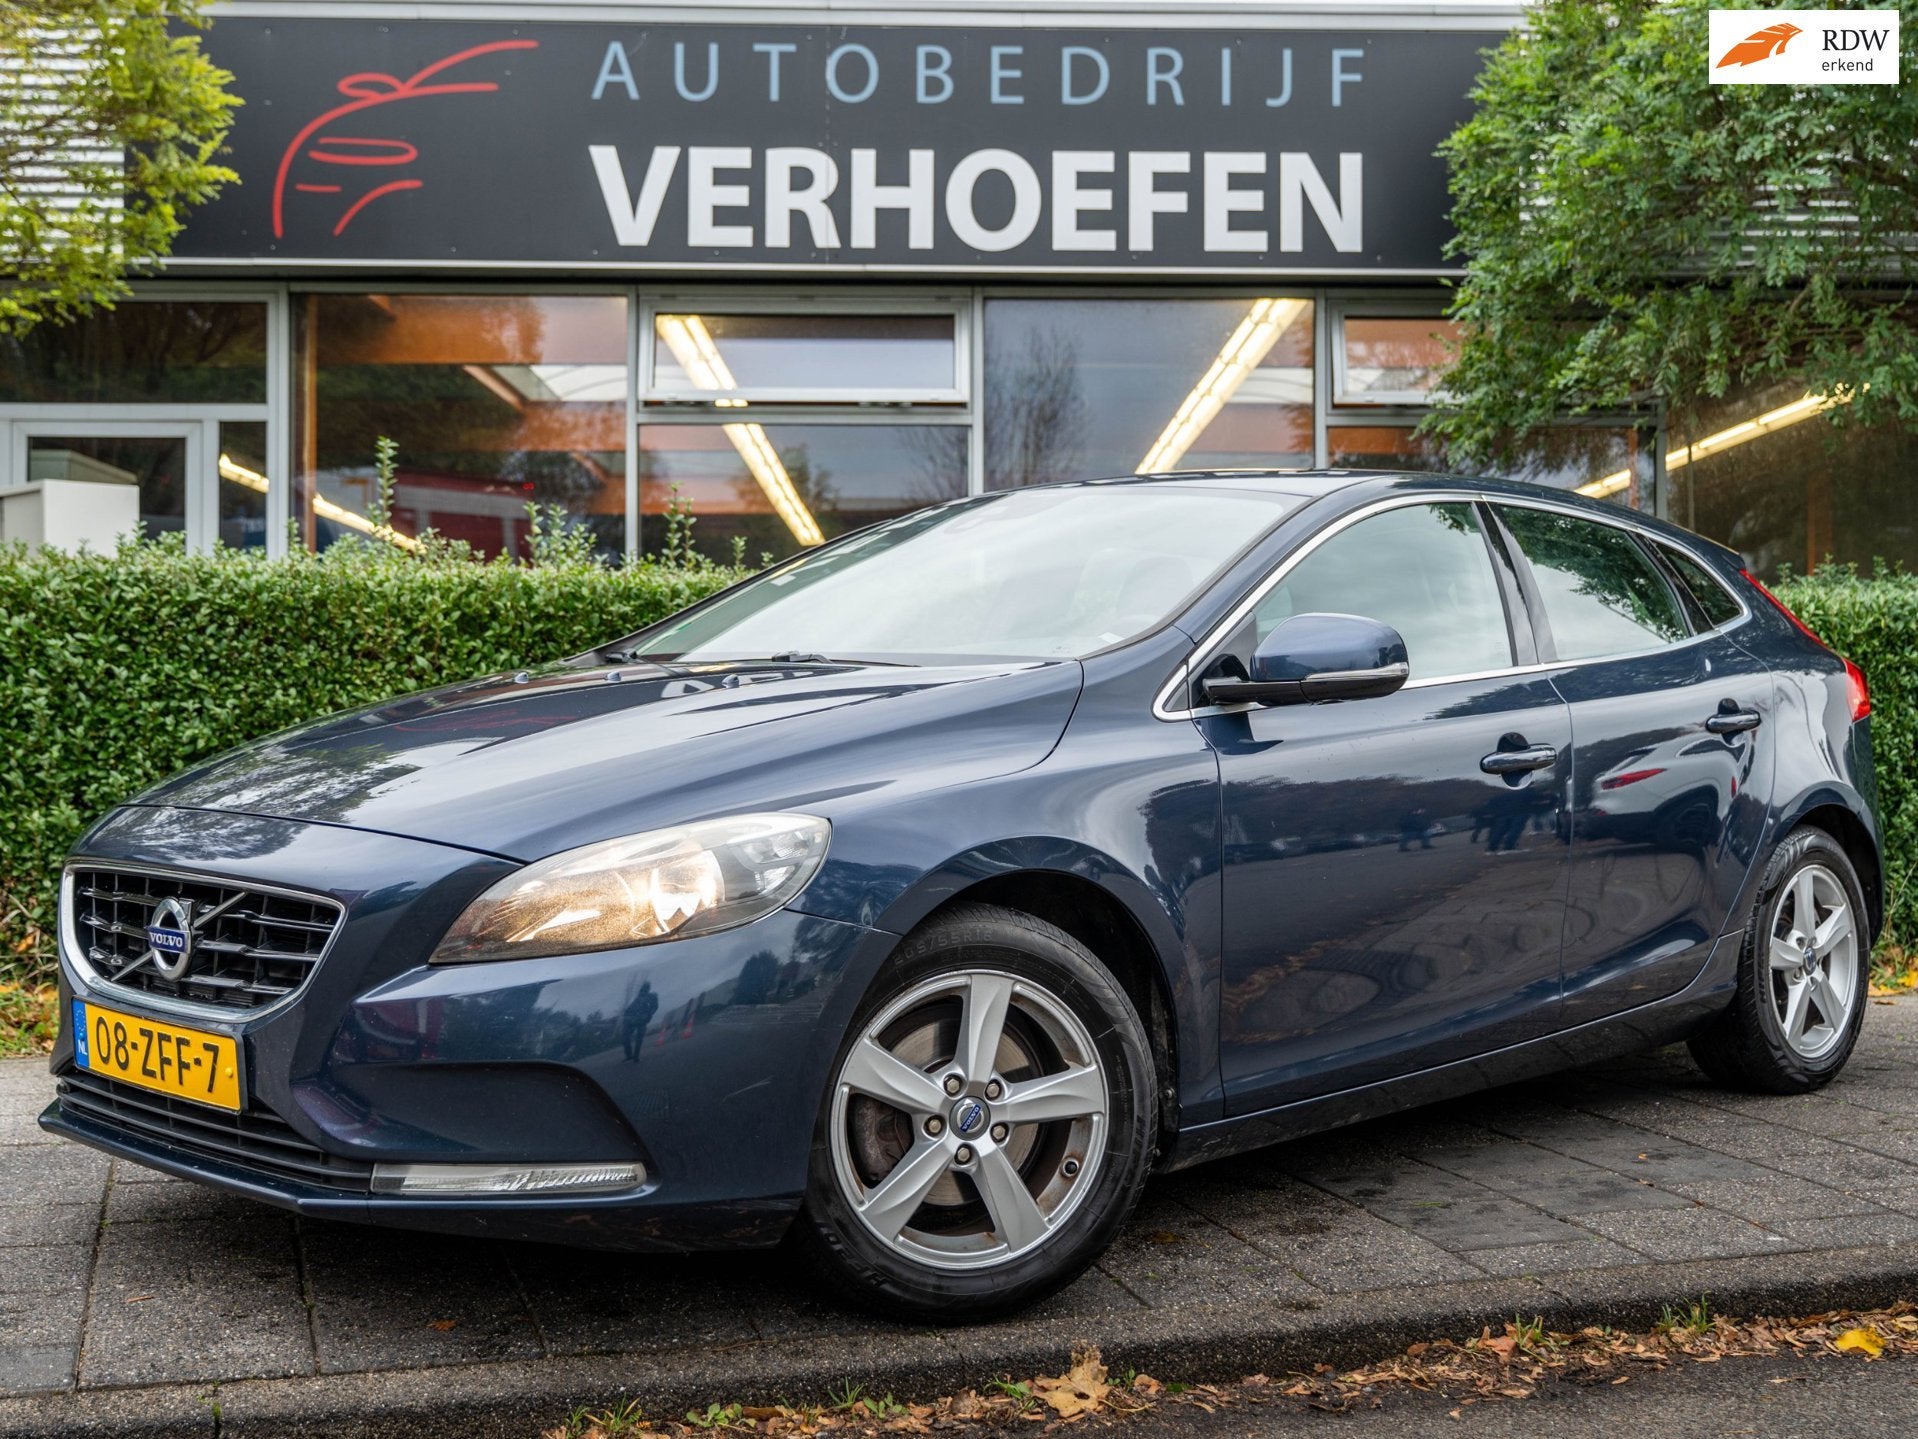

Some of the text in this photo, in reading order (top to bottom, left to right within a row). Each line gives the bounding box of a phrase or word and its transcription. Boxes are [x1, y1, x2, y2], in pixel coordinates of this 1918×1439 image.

[591, 41, 1365, 107] AUTOBEDRIJF
[588, 145, 1364, 253] VERHOEFEN
[149, 931, 184, 949] VOLVO
[77, 1038, 88, 1056] NL
[96, 1016, 220, 1094] 08-ZFF-7
[961, 1106, 980, 1130] VOLVO
